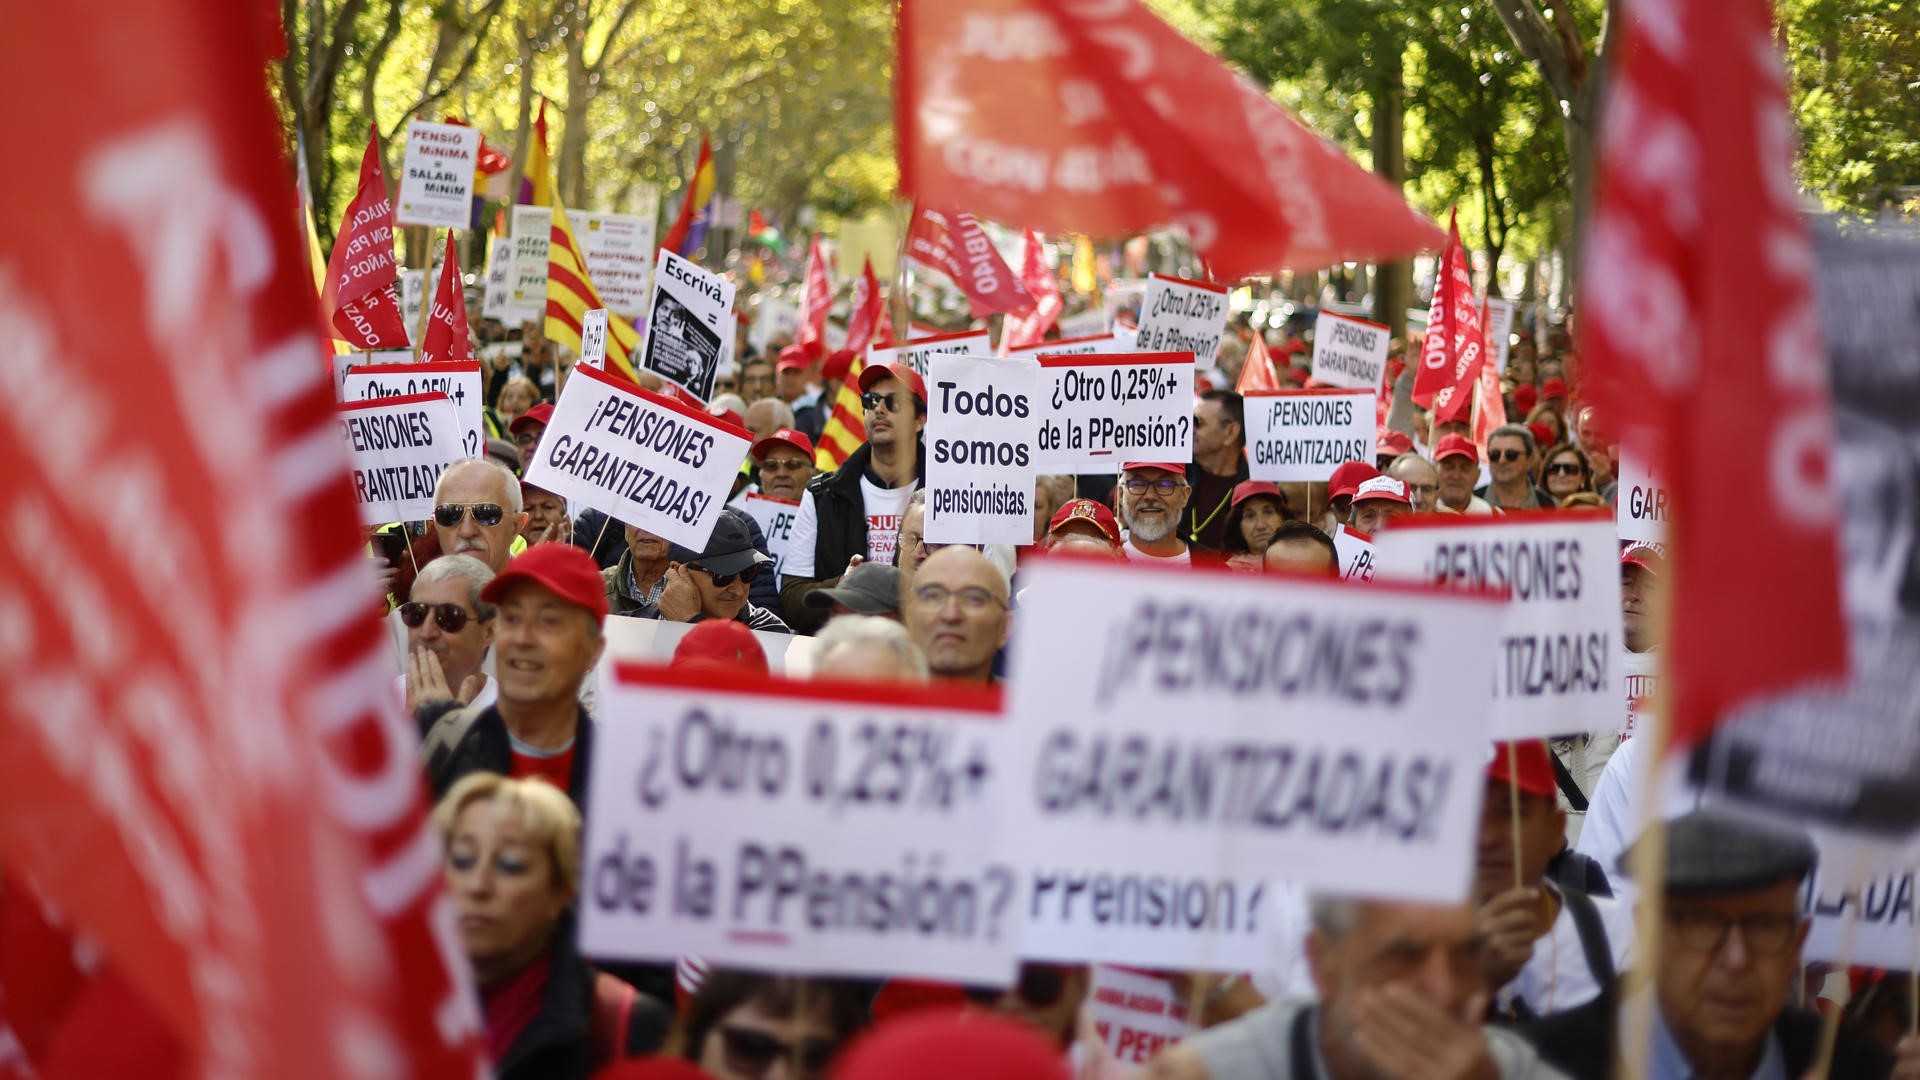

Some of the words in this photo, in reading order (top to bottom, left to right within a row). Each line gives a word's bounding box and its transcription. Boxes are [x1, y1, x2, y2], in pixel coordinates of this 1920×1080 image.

[1136, 324, 1151, 348] de
[1151, 325, 1164, 350] la
[937, 381, 1030, 419] Todos
[1051, 368, 1105, 410] ¿Otro
[1111, 367, 1178, 406] 0,25%+
[584, 394, 715, 469] ¡PENSIONES
[1038, 419, 1061, 450] de
[1066, 419, 1083, 449] la
[1089, 415, 1189, 449] PPensión?
[1267, 401, 1353, 432] ¡PENSIONES
[934, 438, 1030, 467] somos
[1255, 439, 1367, 466] GARANTIZADAS!
[549, 434, 712, 527] GARANTIZADAS!
[933, 482, 1028, 521] pensionistas.
[1096, 600, 1424, 709] ¡PENSIONES
[1492, 634, 1609, 699] TIZADAS!
[637, 709, 792, 809] ¿Otro
[805, 718, 992, 818] 0,25%+
[1032, 730, 1456, 845] GARANTIZADAS!
[593, 832, 658, 914] de
[672, 837, 716, 920] la
[733, 845, 1018, 943] PPensión?
